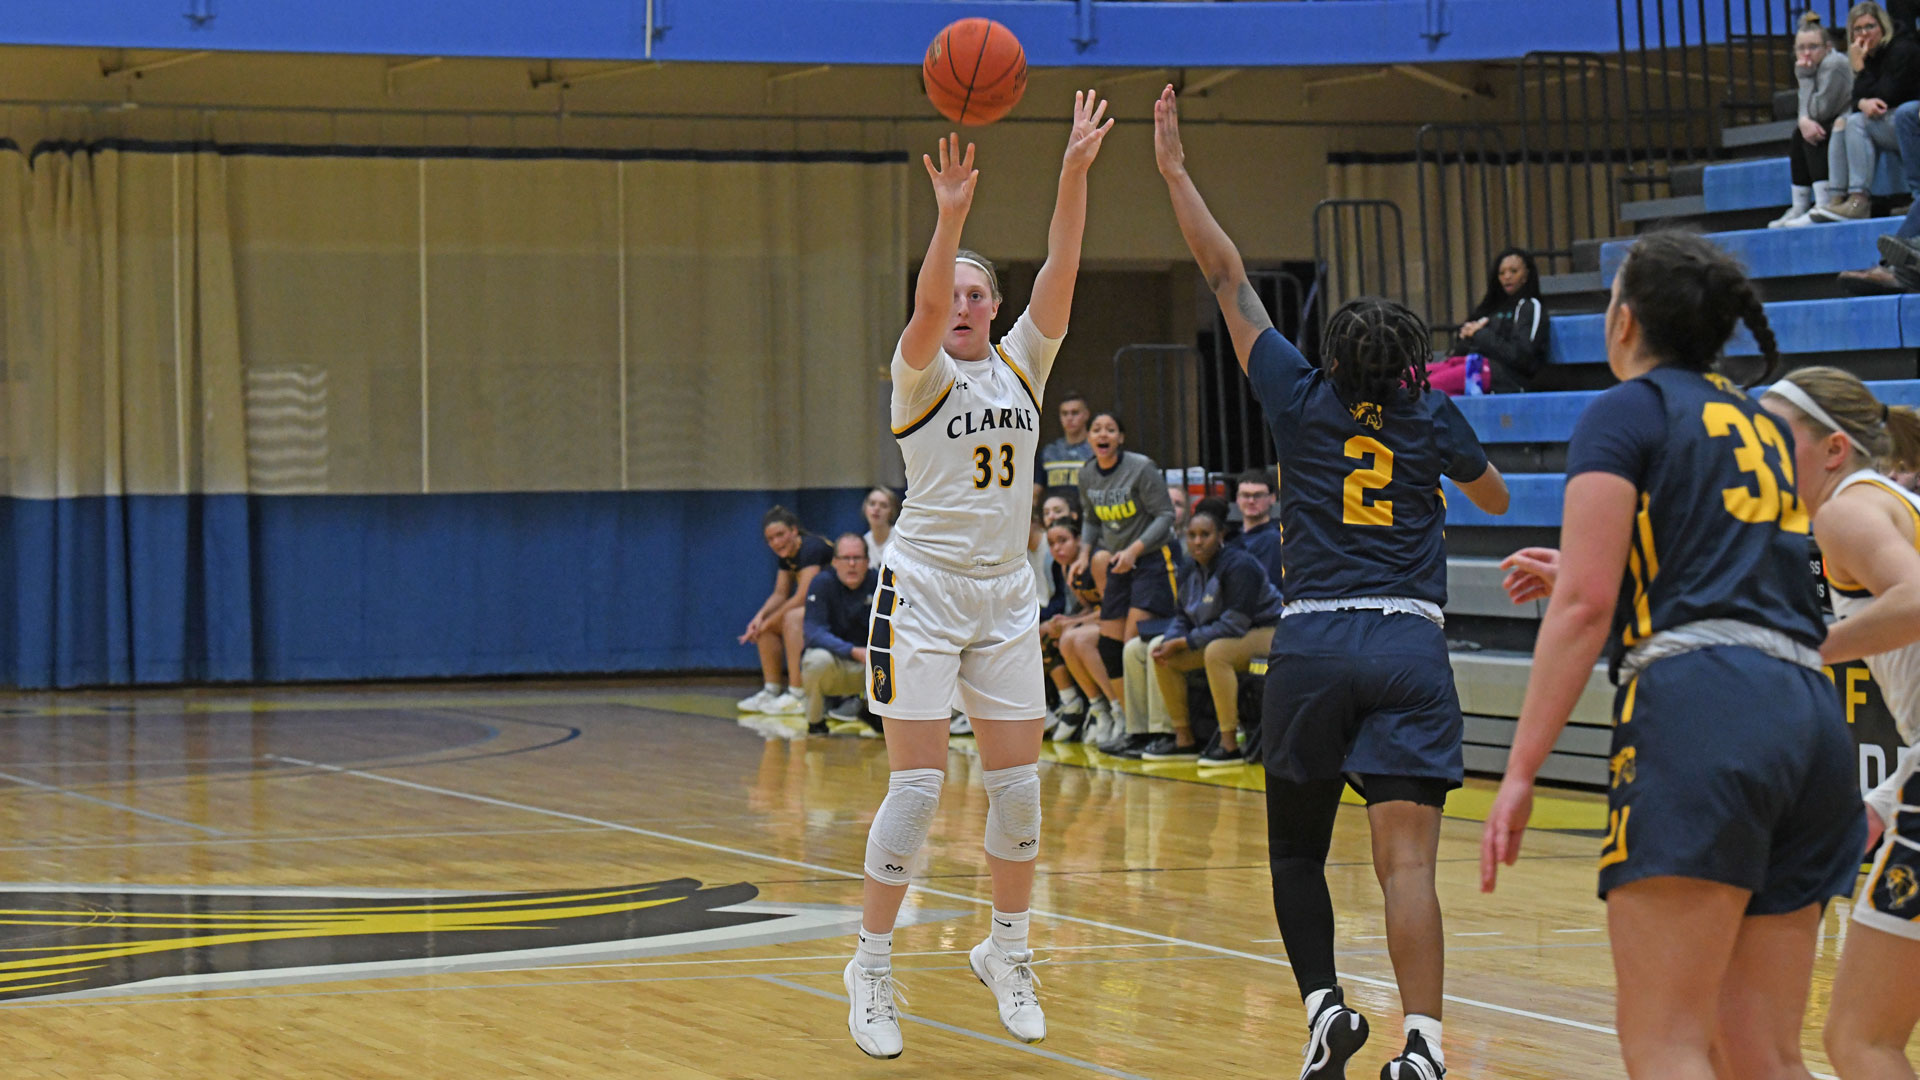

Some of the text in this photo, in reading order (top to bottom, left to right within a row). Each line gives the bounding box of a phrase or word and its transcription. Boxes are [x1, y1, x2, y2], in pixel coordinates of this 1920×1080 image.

[947, 408, 1033, 439] CLARKE
[972, 442, 1015, 489] 33
[1343, 435, 1393, 526] 2
